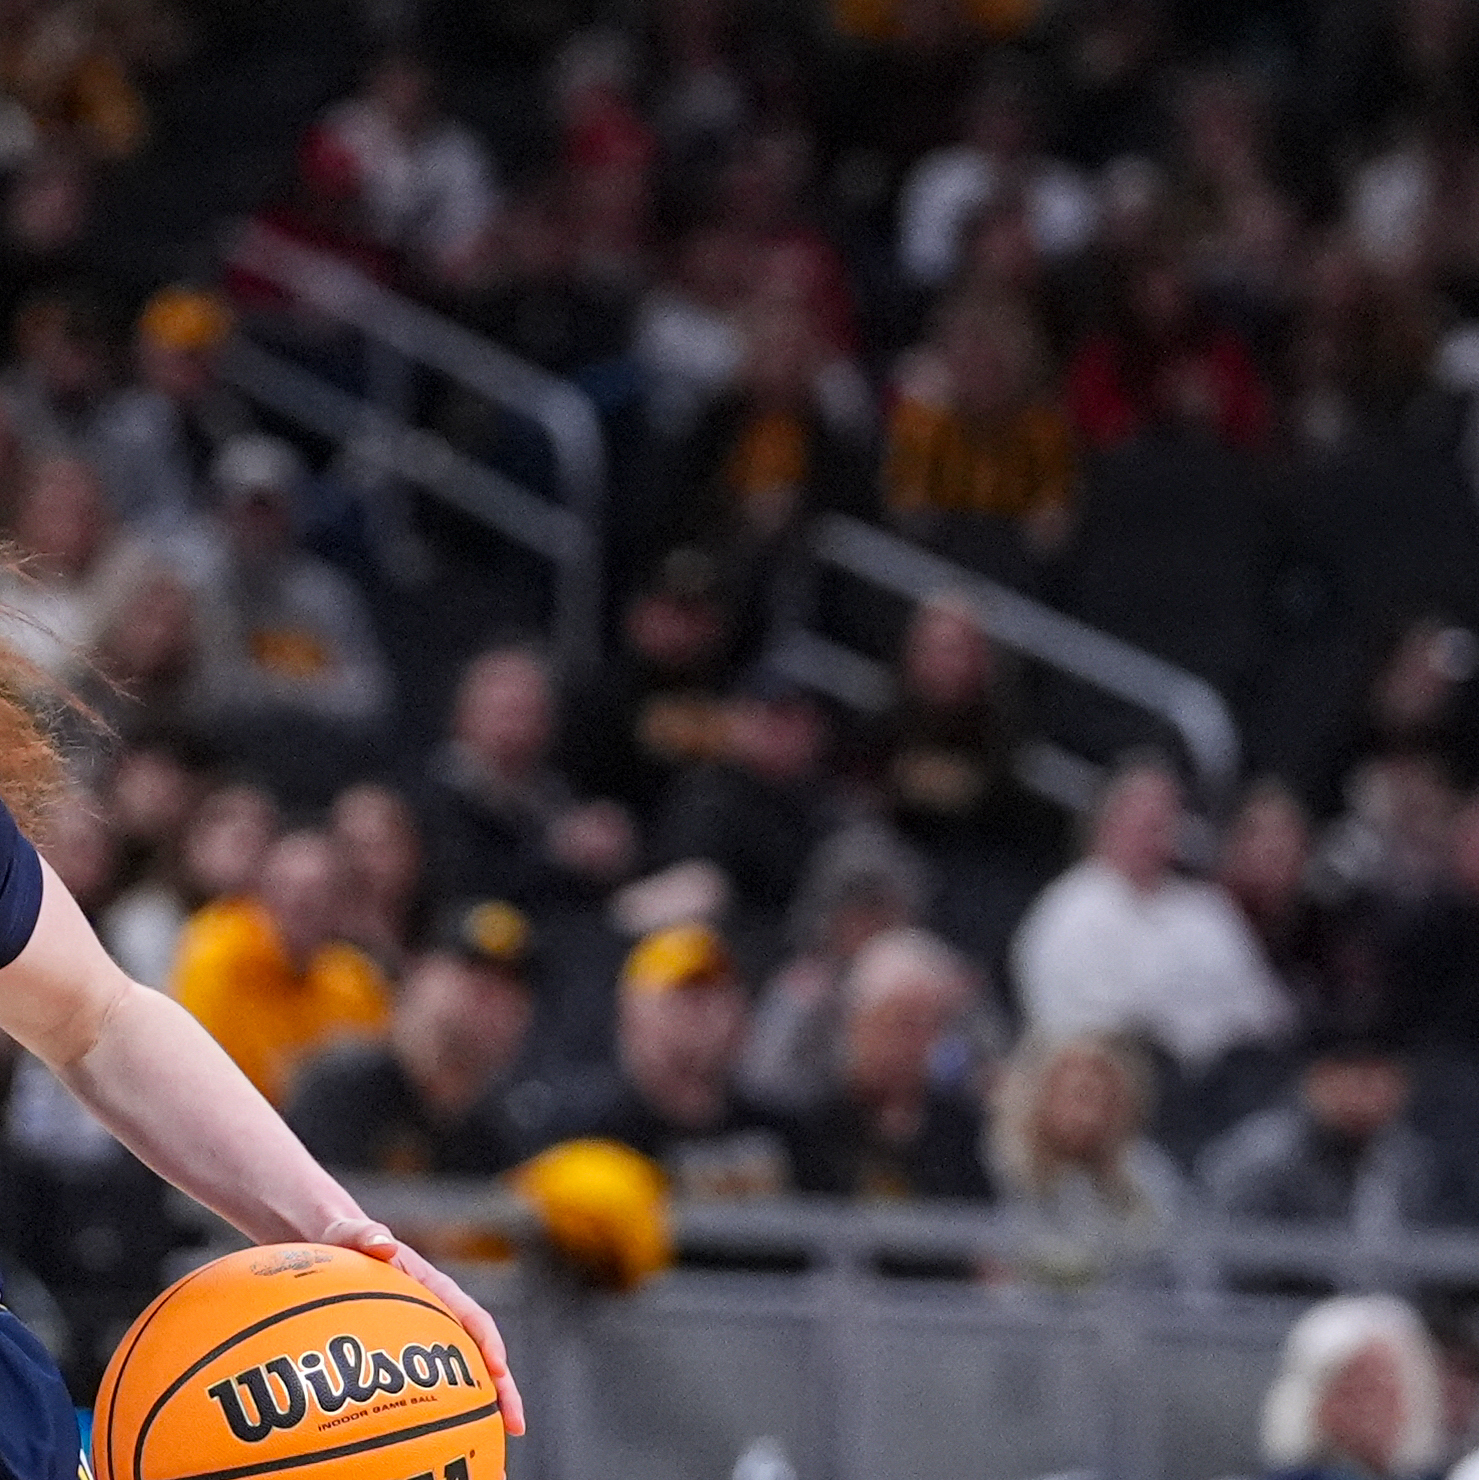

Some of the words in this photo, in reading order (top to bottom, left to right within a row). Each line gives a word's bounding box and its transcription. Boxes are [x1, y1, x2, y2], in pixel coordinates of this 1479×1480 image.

[206, 1334, 475, 1444] Wilson
[318, 1409, 368, 1432] INDOOR
[372, 1400, 408, 1415] GAME
[410, 1395, 438, 1406] BALL
